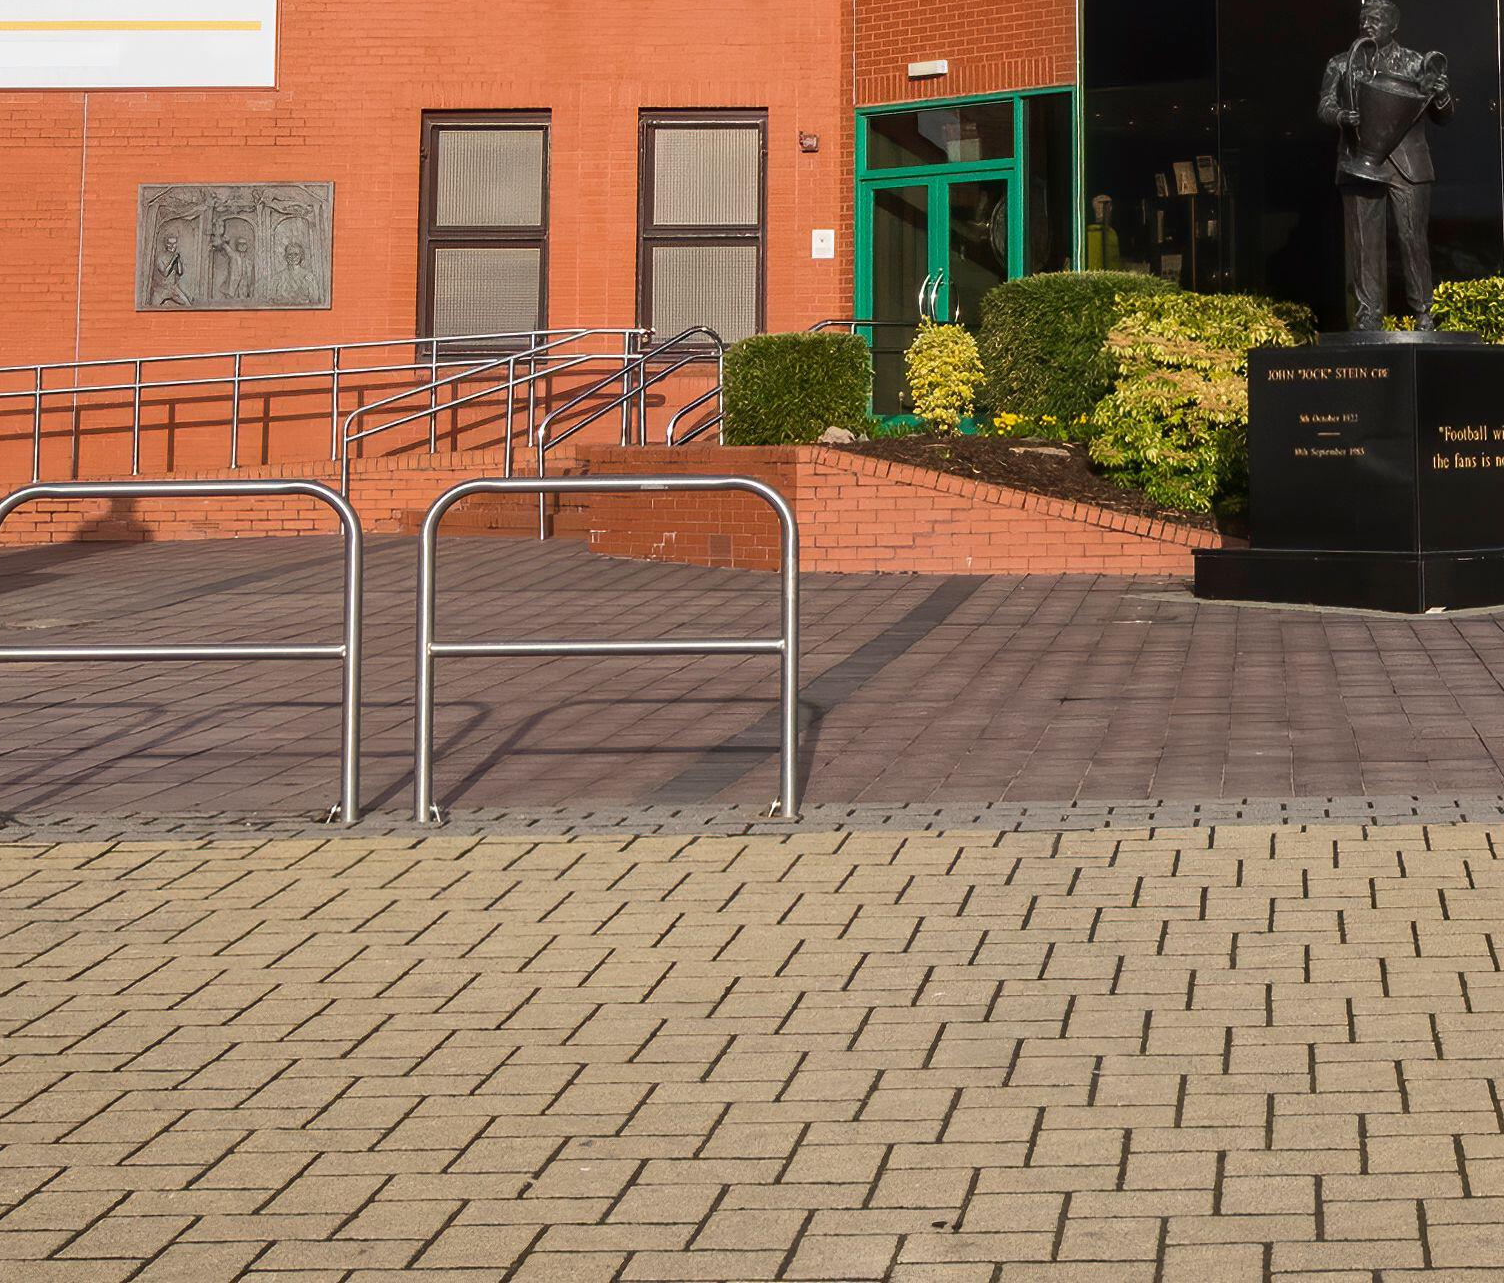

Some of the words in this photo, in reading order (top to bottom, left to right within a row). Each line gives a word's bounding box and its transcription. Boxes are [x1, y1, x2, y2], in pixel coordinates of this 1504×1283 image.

[1267, 369, 1294, 381] JOHN
[1335, 367, 1368, 379] STEIN
[1438, 425, 1487, 441] "Football
[1433, 453, 1450, 469] the
[1455, 452, 1476, 469] fans
[1481, 451, 1491, 467] is
